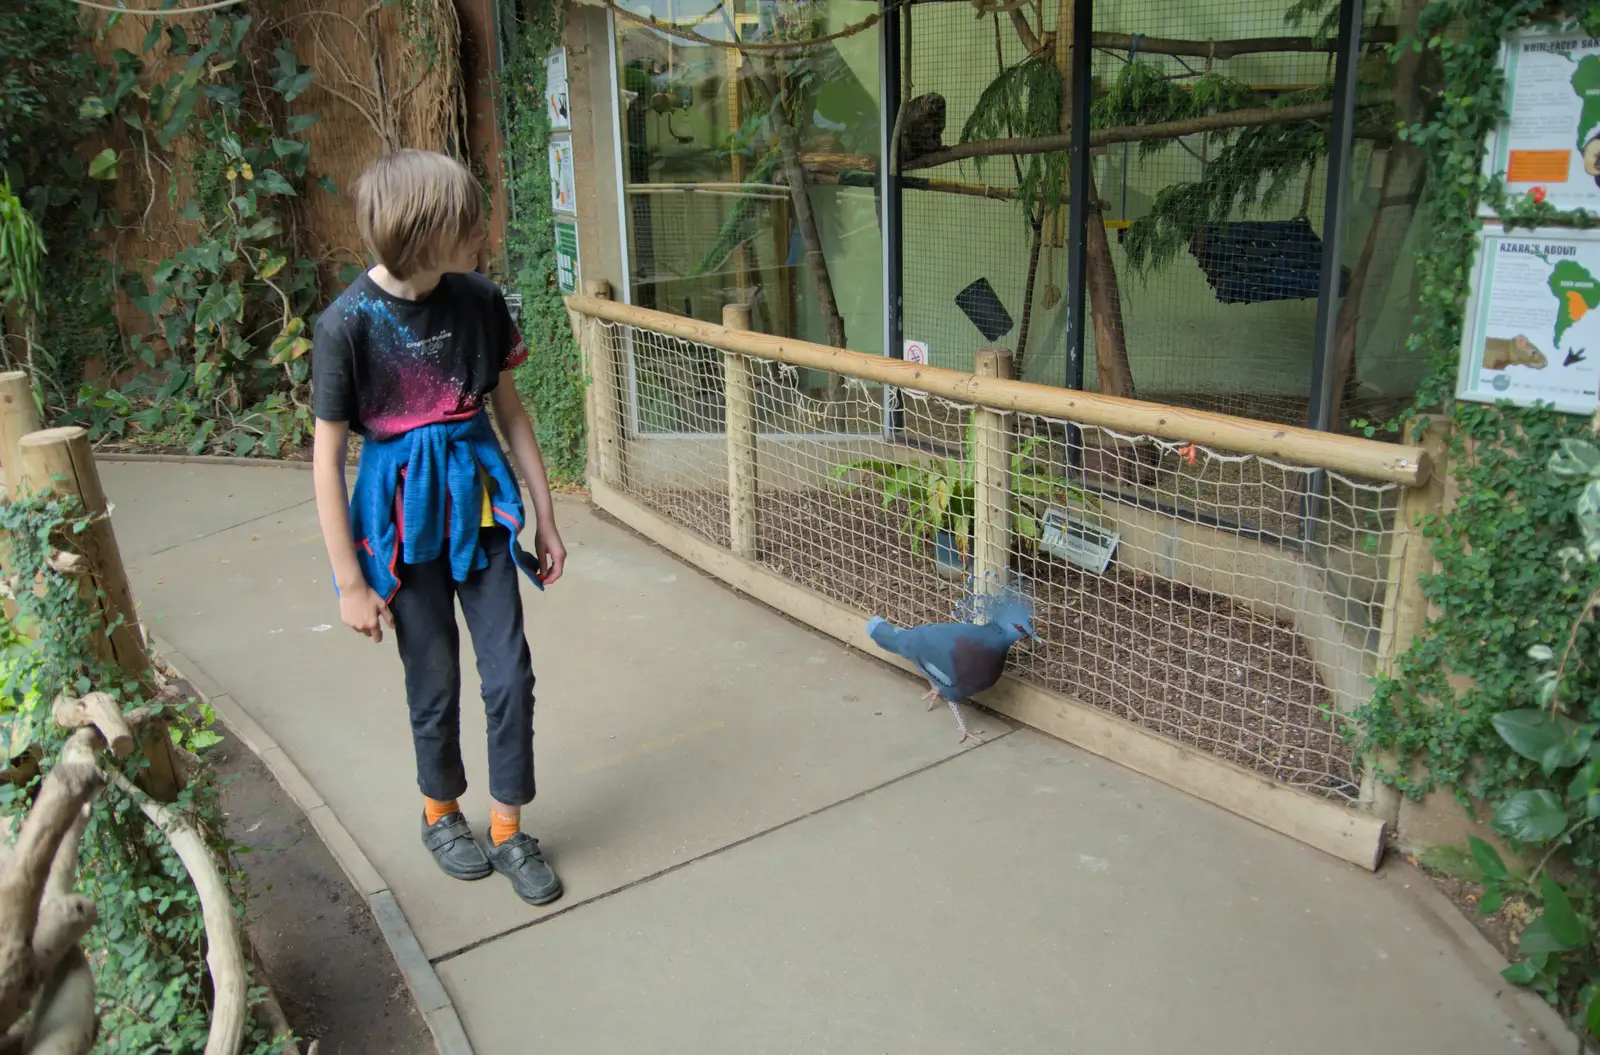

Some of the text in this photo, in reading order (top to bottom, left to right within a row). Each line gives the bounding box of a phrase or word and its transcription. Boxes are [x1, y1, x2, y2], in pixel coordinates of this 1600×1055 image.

[1523, 40, 1578, 52] WHITE-FACED
[1500, 243, 1577, 256] AZARA'S AGOUTI
